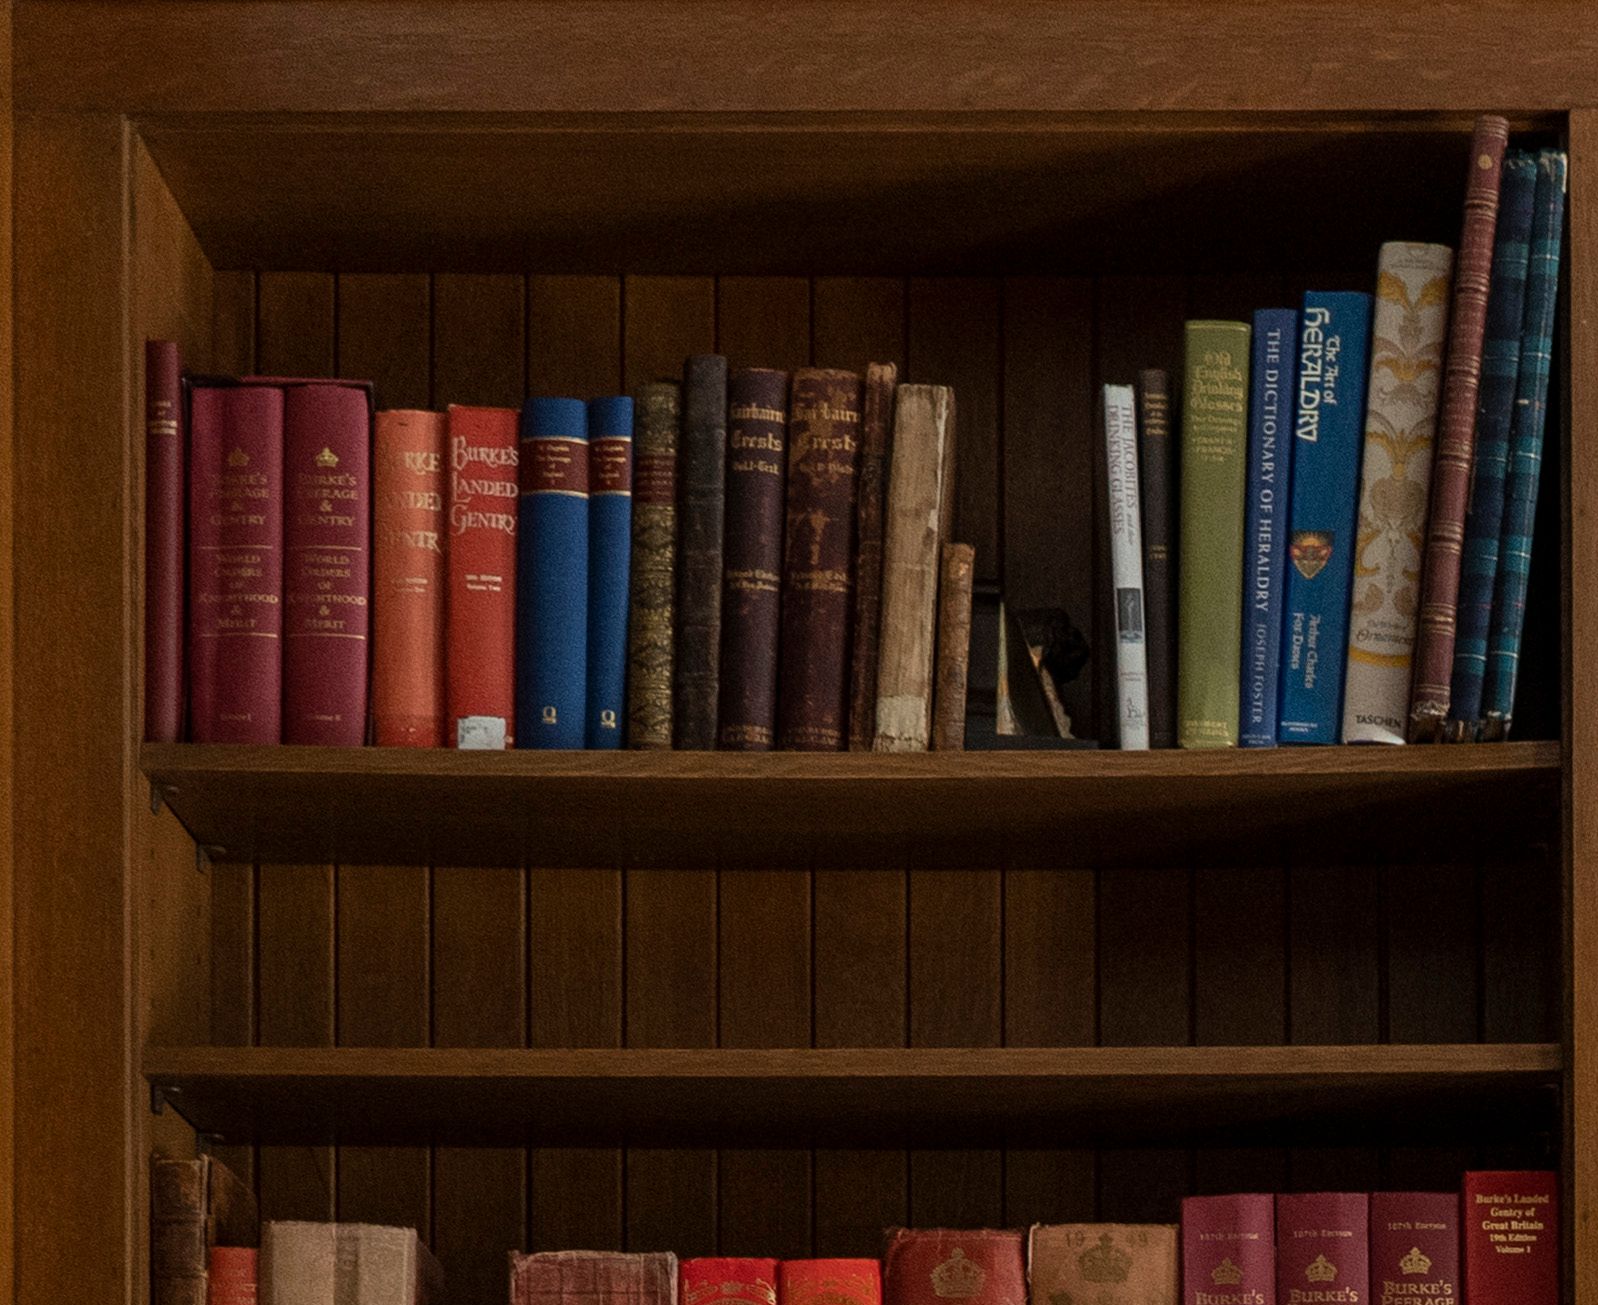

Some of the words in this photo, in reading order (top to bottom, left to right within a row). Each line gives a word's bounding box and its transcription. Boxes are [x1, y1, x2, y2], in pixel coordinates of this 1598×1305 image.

[1267, 328, 1281, 363] THE
[1260, 370, 1280, 484] DICTIONARY
[1260, 491, 1274, 513] OF
[1256, 520, 1273, 611] HERALDRY
